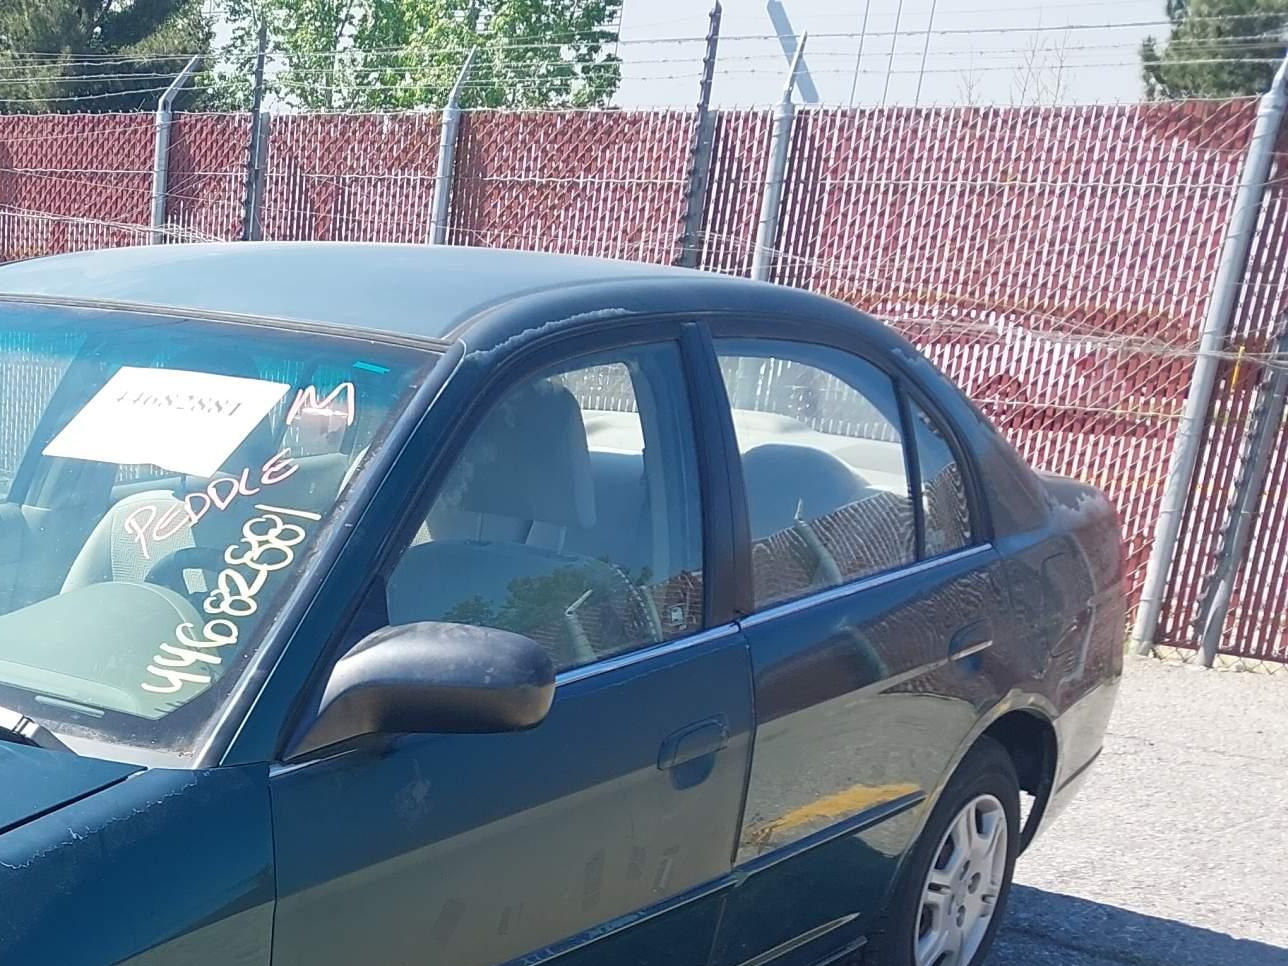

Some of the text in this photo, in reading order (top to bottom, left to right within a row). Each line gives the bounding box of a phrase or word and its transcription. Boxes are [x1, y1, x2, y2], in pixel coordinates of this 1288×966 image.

[285, 382, 356, 426] M
[124, 448, 299, 560] PEDDLE
[140, 504, 322, 694] 44682881
